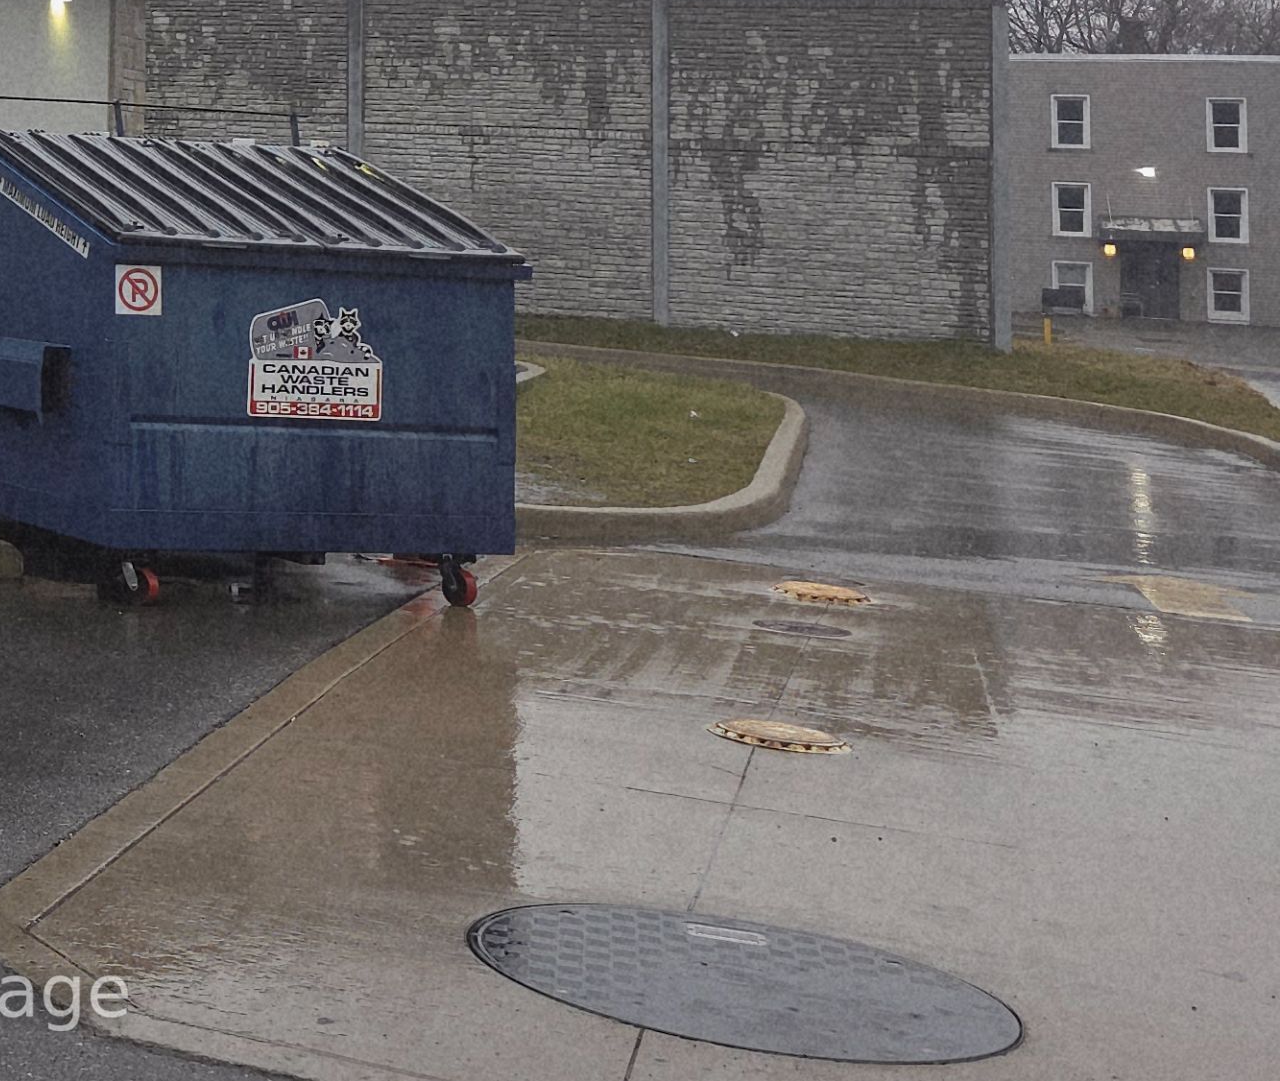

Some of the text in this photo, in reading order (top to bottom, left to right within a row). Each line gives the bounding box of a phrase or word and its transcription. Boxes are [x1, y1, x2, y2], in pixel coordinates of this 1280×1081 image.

[255, 342, 277, 354] YOUR
[263, 363, 369, 377] CANADIAN
[281, 374, 349, 386] WASTE
[261, 384, 369, 397] HANDLERS
[255, 401, 374, 417] 905-384-1114
